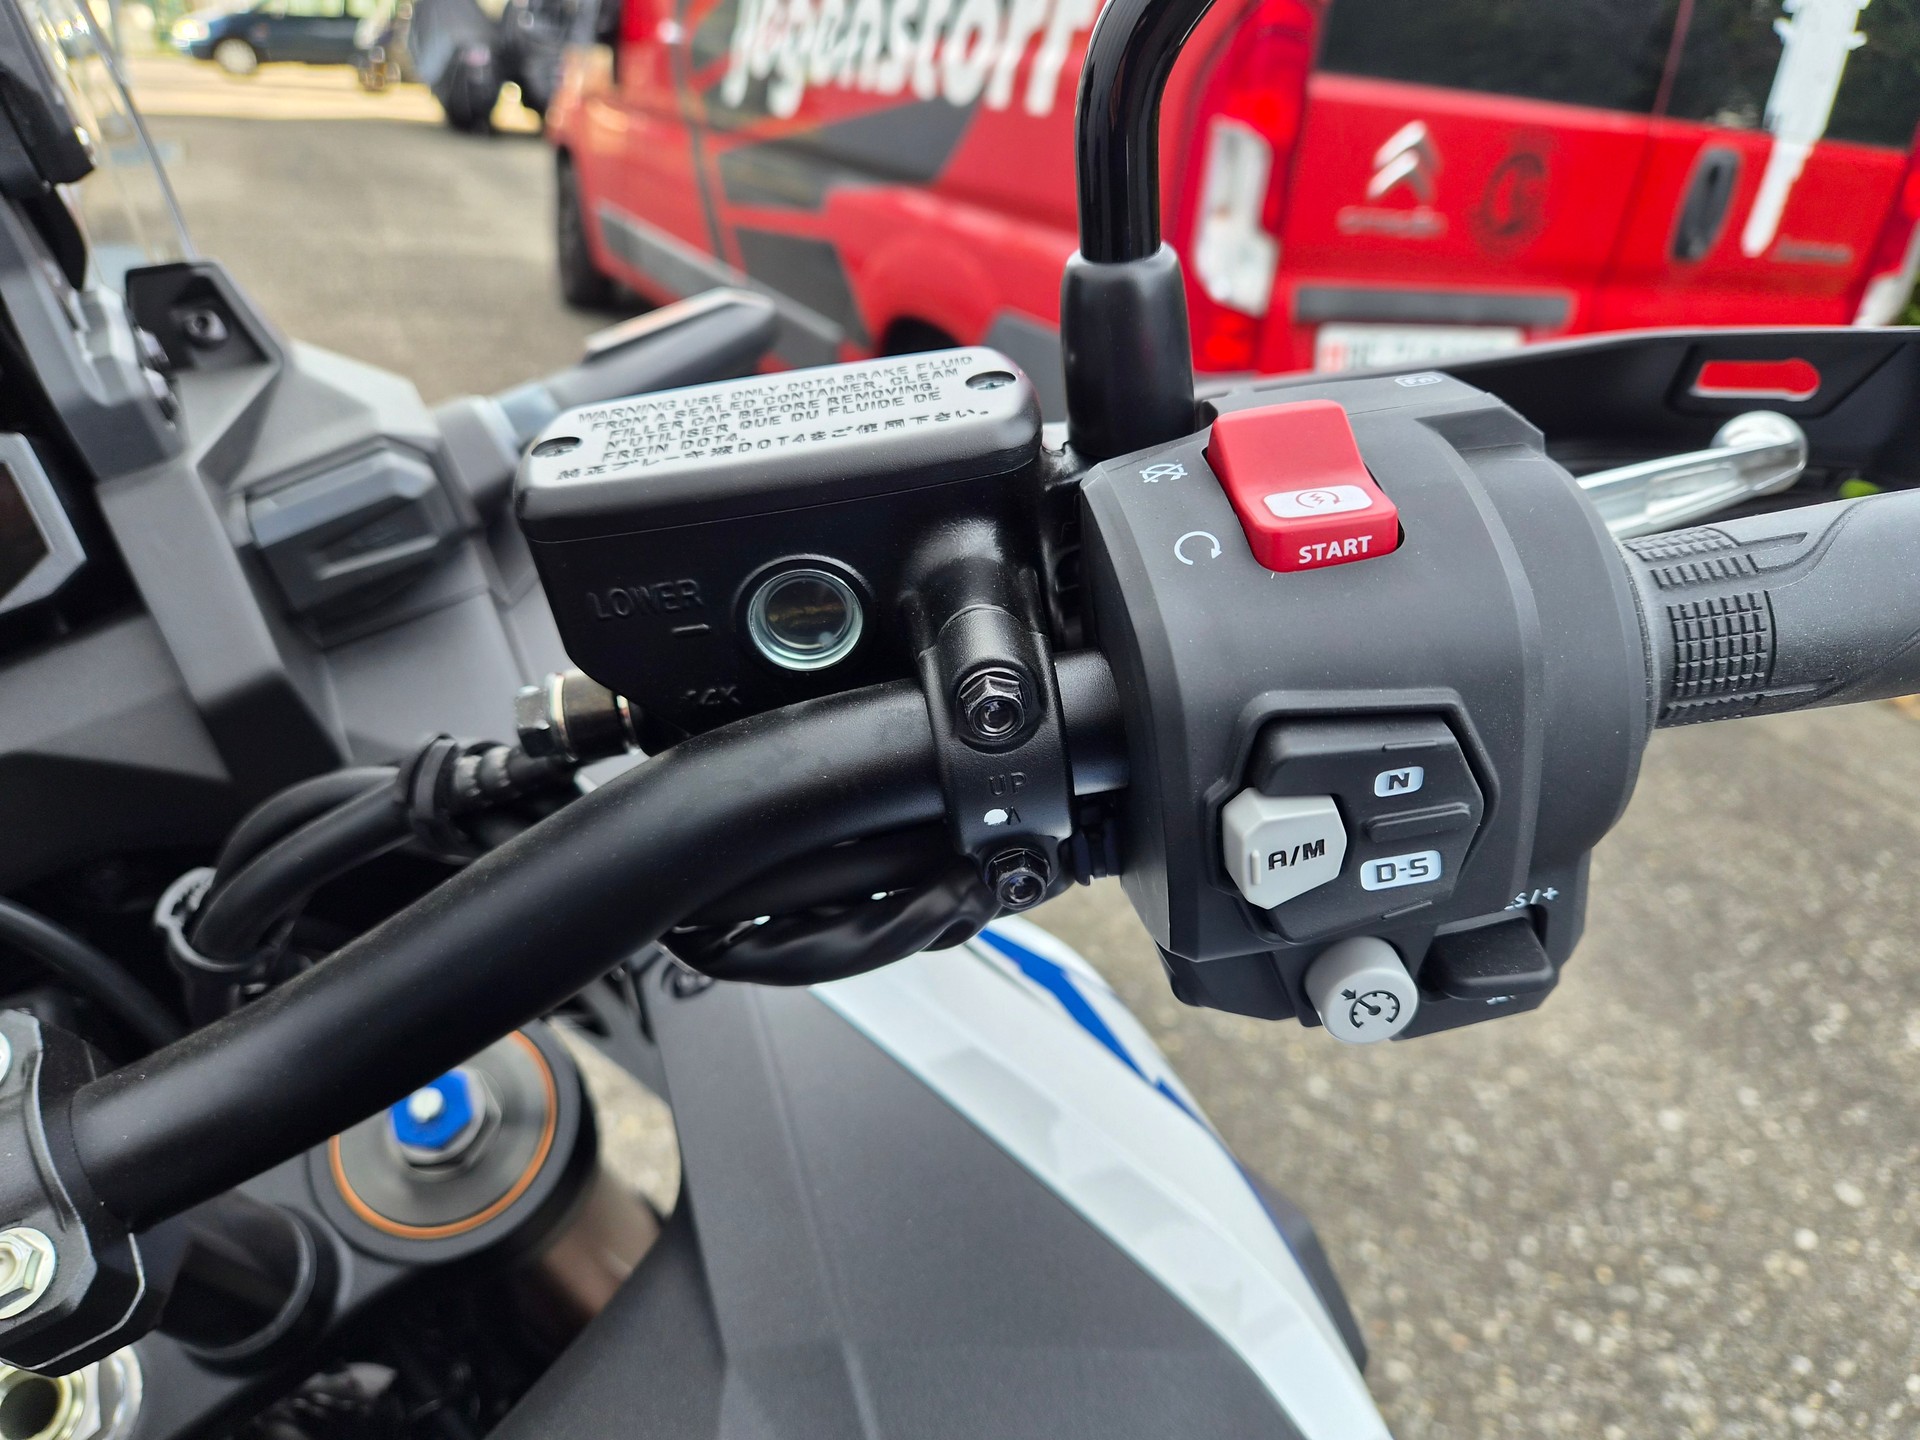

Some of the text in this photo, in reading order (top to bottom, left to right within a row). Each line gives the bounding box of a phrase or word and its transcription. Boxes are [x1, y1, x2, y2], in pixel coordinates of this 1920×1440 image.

[578, 356, 973, 424] WARNING USE ONLY DOT4 BRAKE FLUID
[591, 416, 647, 432] FROM
[654, 412, 666, 422] A
[674, 398, 756, 419] SEALED
[891, 368, 958, 385] CLEAN
[609, 420, 684, 440] FILLER
[691, 412, 732, 428] CAP
[739, 399, 820, 419] BEFORE
[740, 416, 781, 431] QUE
[791, 409, 820, 423] DU
[828, 397, 905, 417] FLUIDE
[914, 390, 942, 404] DE
[602, 443, 669, 462] FREIN
[1299, 535, 1373, 564] START
[586, 579, 703, 618] LOWER
[989, 771, 1027, 796] UP
[1388, 772, 1410, 790] N
[1268, 839, 1326, 870] A/M
[1376, 857, 1429, 883] D-S
